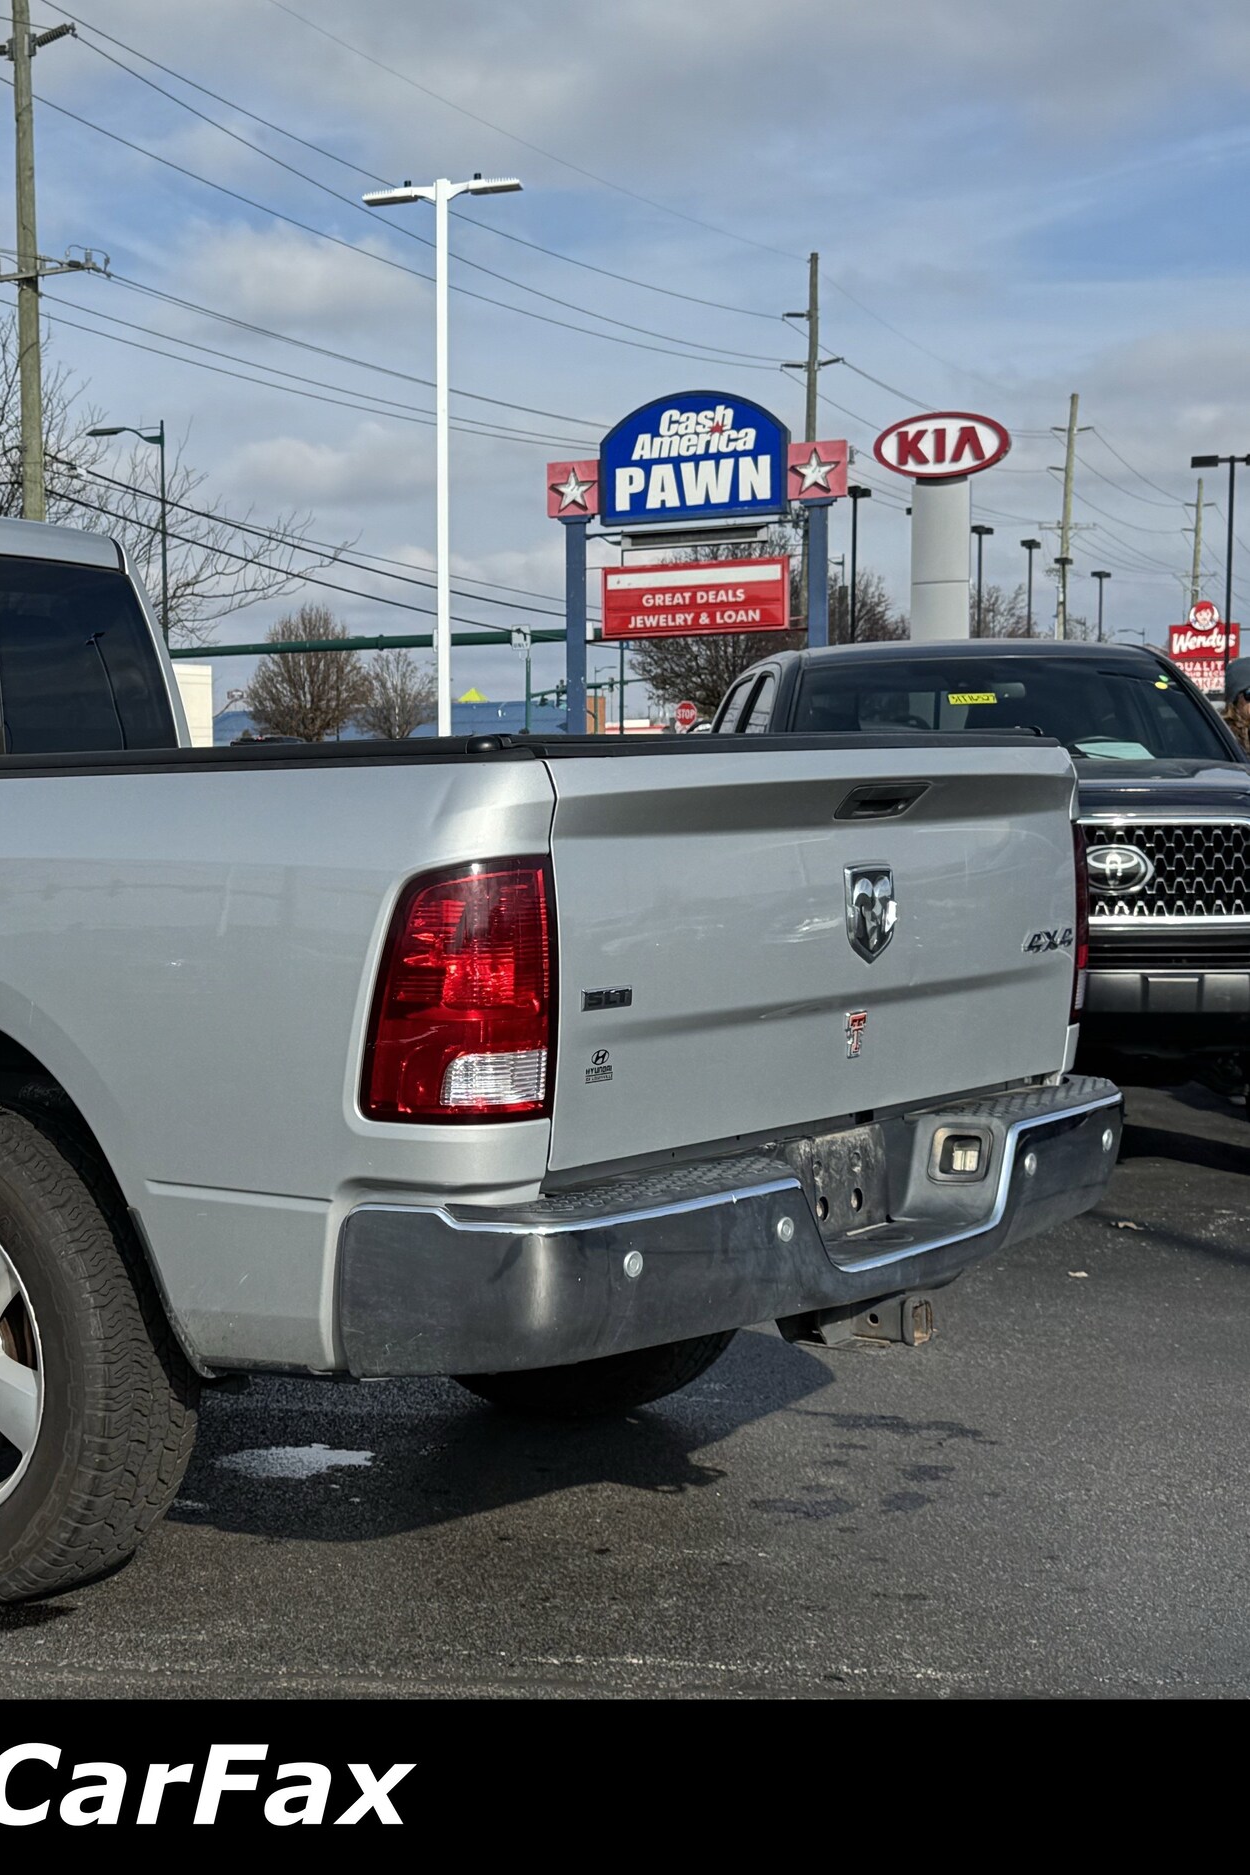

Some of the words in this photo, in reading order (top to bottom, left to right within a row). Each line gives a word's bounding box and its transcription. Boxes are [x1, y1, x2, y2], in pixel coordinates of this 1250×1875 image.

[659, 405, 734, 436] Cash
[631, 427, 756, 461] America
[895, 426, 985, 466] KIA
[615, 454, 771, 512] PAWN
[642, 592, 691, 607] GREAT
[696, 588, 746, 604] DEALS
[628, 612, 695, 629] JEWELRY
[699, 611, 711, 625] &
[716, 609, 761, 624] LOAN
[1172, 627, 1237, 655] Wendys
[1175, 660, 1226, 672] QUALIT
[676, 708, 696, 719] STOP
[585, 988, 631, 1009] SLT
[585, 1064, 613, 1075] HYUNDAI
